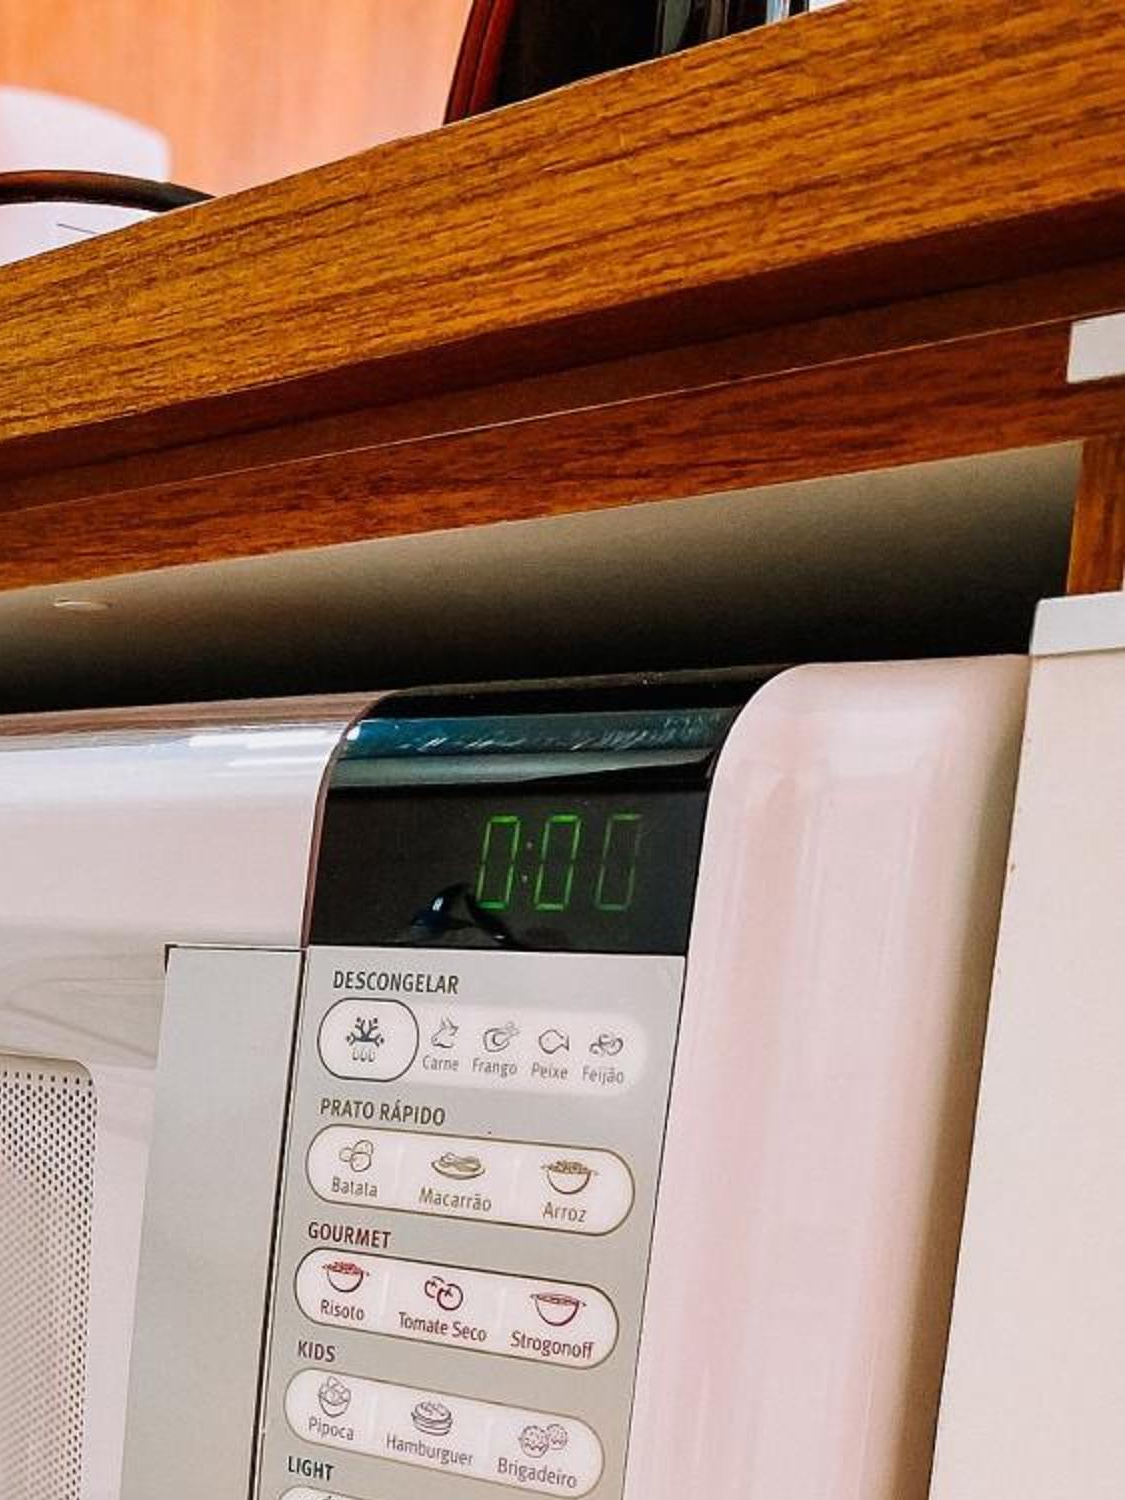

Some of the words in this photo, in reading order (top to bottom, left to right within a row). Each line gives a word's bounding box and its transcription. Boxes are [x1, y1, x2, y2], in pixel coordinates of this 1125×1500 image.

[476, 814, 642, 912] 0:00
[333, 970, 459, 995] DESCONGELAR
[422, 1057, 459, 1072] Carne
[472, 1058, 518, 1077] Frango
[531, 1061, 568, 1080] Peixe
[582, 1066, 624, 1085] Feijão
[320, 1097, 374, 1120] PRATO
[379, 1099, 446, 1126] RÁPIDO
[331, 1176, 378, 1198] Batata
[419, 1187, 492, 1212] Macarrão
[542, 1201, 587, 1223] Arroz
[308, 1221, 391, 1249] GOURMET
[320, 1300, 365, 1322] Risoto
[398, 1312, 449, 1336] Tomate
[452, 1321, 487, 1343] Seco
[511, 1331, 594, 1359] Strogonoff
[297, 1340, 336, 1363] KIDS
[308, 1416, 355, 1441] Pipoca
[386, 1434, 474, 1467] Hamburguer
[497, 1457, 577, 1489] Brigadeiro
[288, 1455, 335, 1482] LIGHT
